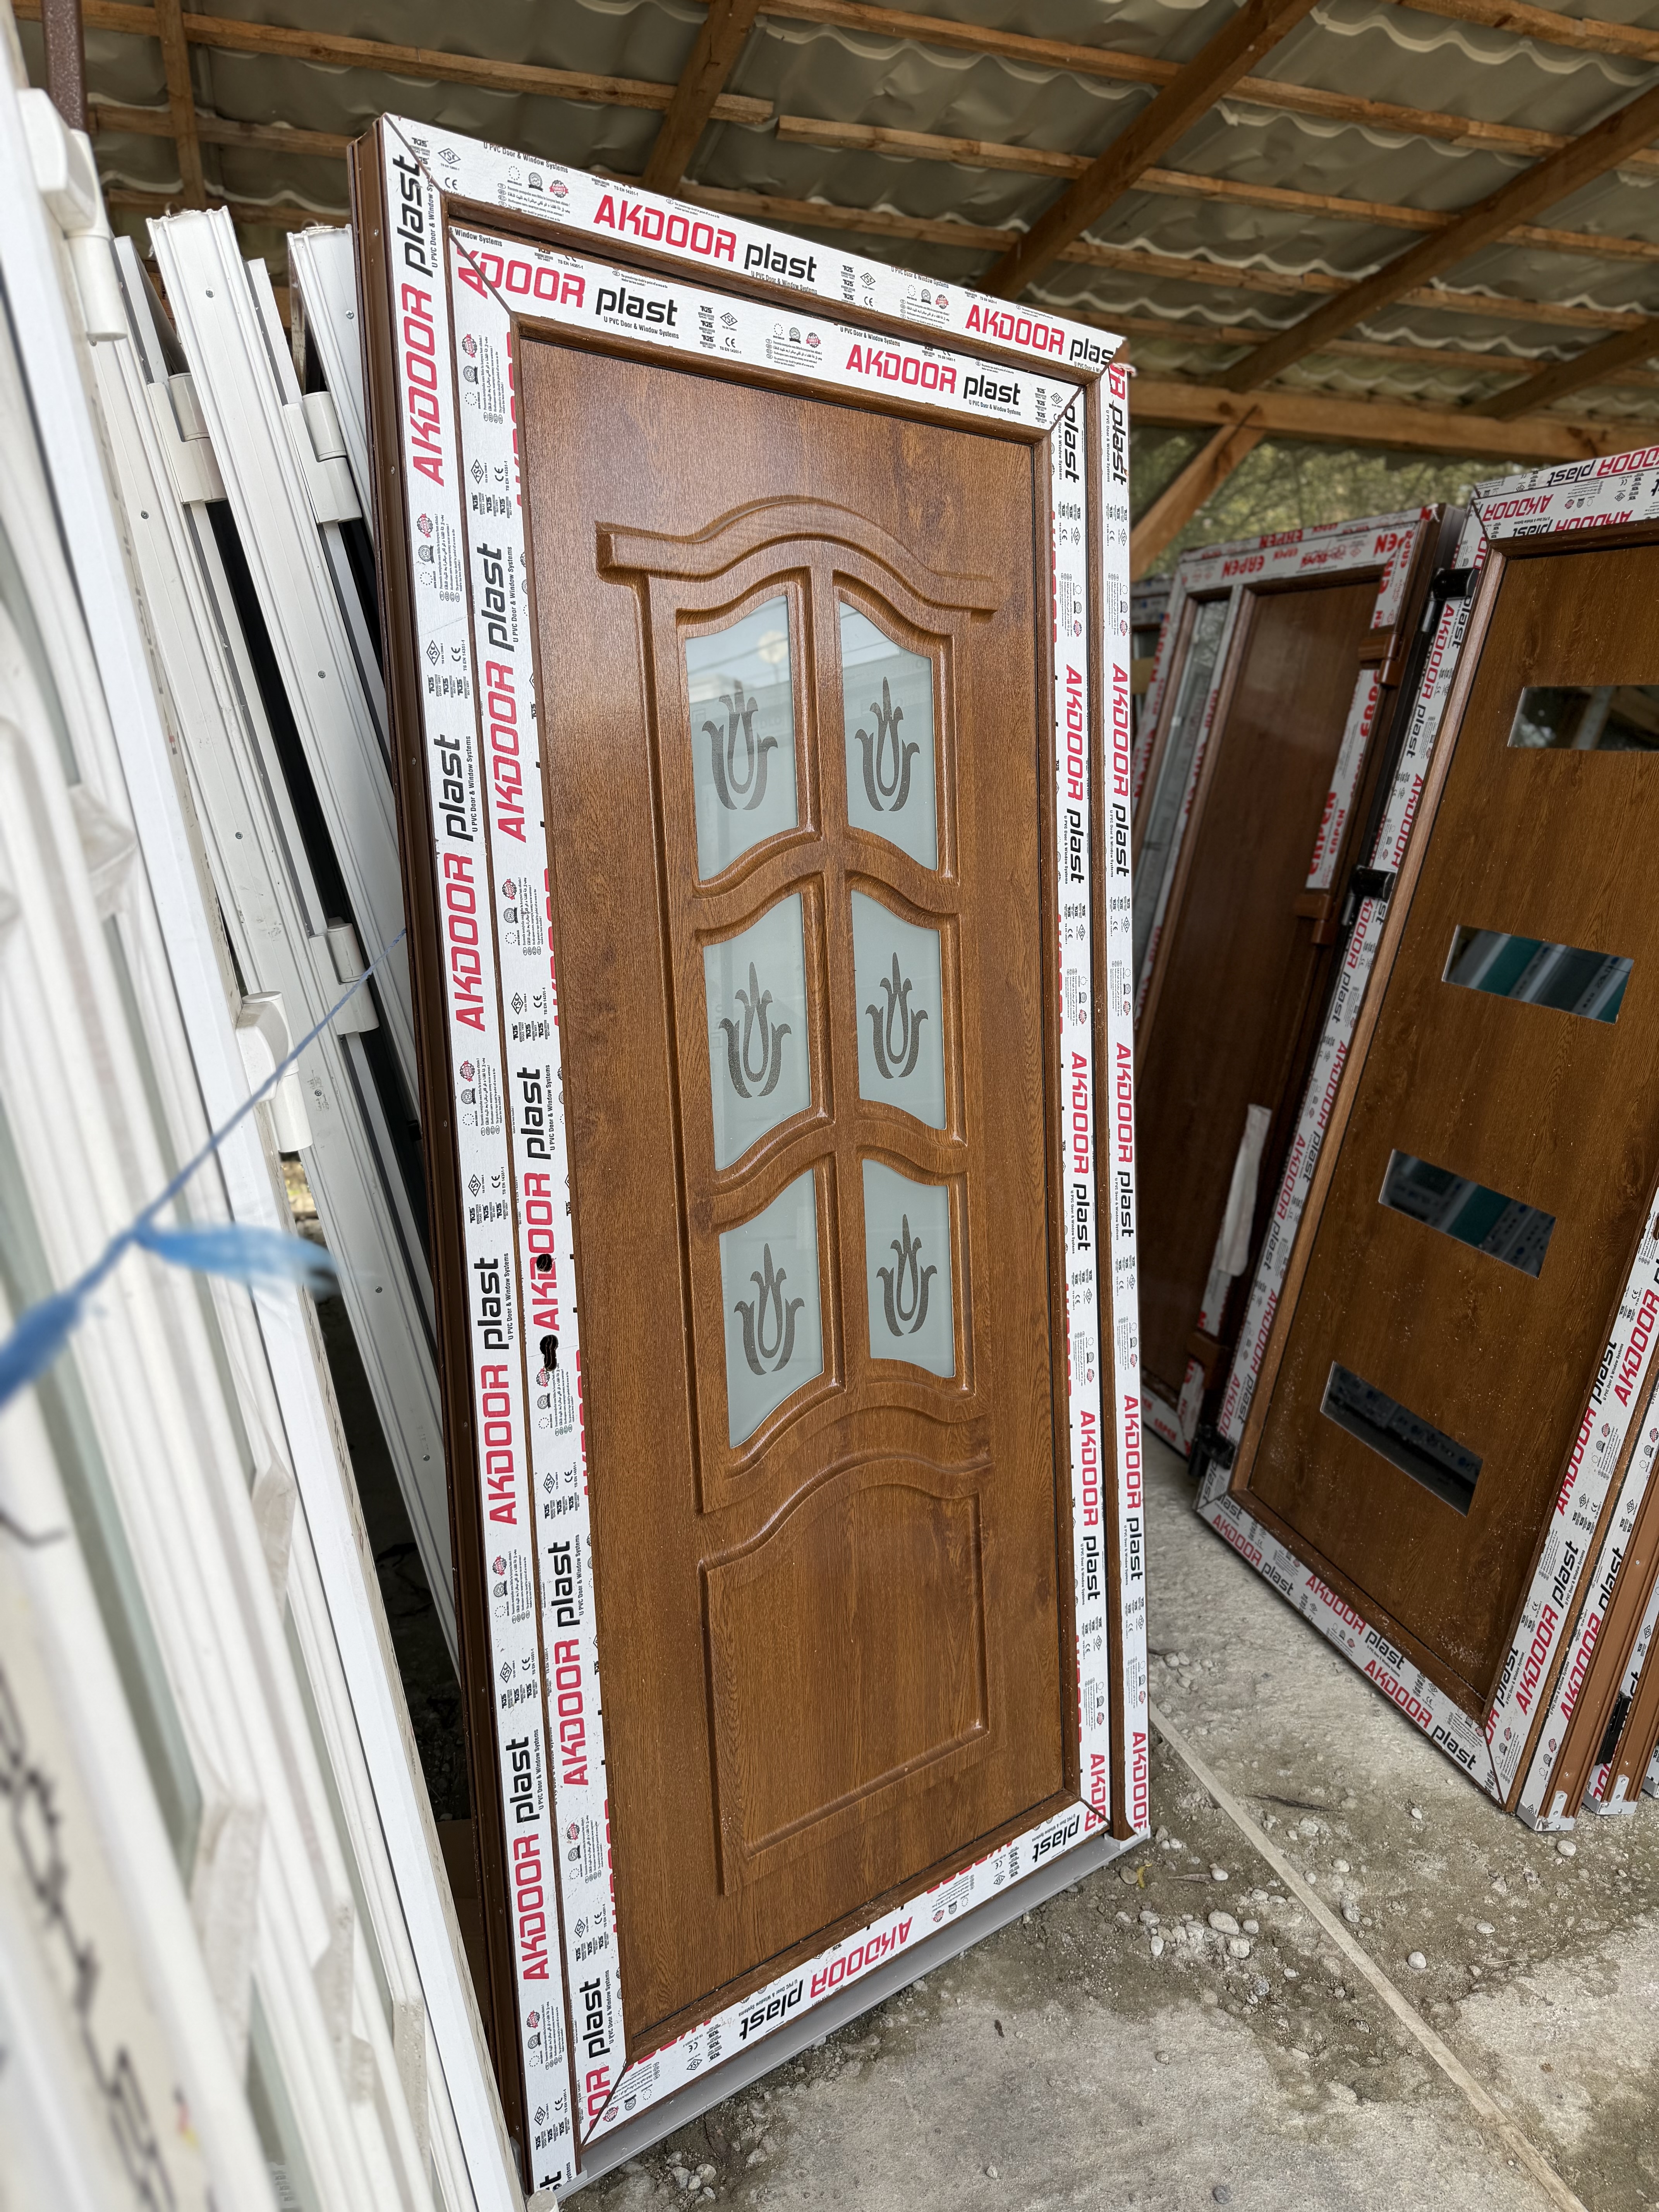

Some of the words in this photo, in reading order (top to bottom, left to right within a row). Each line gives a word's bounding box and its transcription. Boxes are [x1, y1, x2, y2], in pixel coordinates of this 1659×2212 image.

[392, 153, 433, 278] plast
[594, 195, 736, 262] AKDOOR
[744, 243, 817, 282] plast
[595, 287, 678, 326] plast
[609, 317, 619, 325] PVC
[620, 320, 632, 328] Door
[639, 324, 658, 334] Window
[659, 329, 679, 339] Systems
[965, 305, 1065, 355] AKDOOR
[1069, 338, 1118, 373] plas
[401, 283, 443, 486] AKDOOR
[846, 345, 957, 393] AKDOOR
[963, 374, 1021, 405] plast
[1109, 400, 1127, 486] plast
[1545, 460, 1597, 488] plast
[1596, 447, 1659, 477] DOOR
[1482, 495, 1553, 522] AKDOOR
[1512, 519, 1554, 538] plast
[1554, 511, 1632, 532] AKDOOR
[476, 543, 515, 653] plast
[451, 647, 461, 662] CE
[1422, 605, 1454, 699] AKDOOR
[486, 661, 526, 842] AKDOOR
[1066, 665, 1083, 801] AKDOOR
[1113, 664, 1128, 796] AKDOOR
[1406, 703, 1426, 758] plast
[433, 734, 474, 842] plast
[1392, 774, 1424, 868] AKDOOR
[1066, 808, 1084, 884] plast
[1112, 803, 1129, 877] plast
[1329, 808, 1346, 855] ERPEN
[443, 853, 485, 1031] AKDOOR
[1346, 900, 1373, 969] KDOOR
[1332, 971, 1351, 1023] plast
[517, 1067, 551, 1160] plast
[1072, 1052, 1089, 1174] AKDOOR
[1116, 1043, 1132, 1163] AKDOOR
[1317, 1041, 1347, 1130] AKDOOR
[1276, 1135, 1306, 1220] AKDOOR
[1303, 1129, 1325, 1184] plast
[1072, 1183, 1091, 1251] plast
[1117, 1171, 1134, 1237] plast
[1258, 1219, 1281, 1273] plast
[474, 1257, 509, 1350] plast
[1614, 1290, 1659, 1407] AKDOOR
[1218, 1375, 1240, 1437] AKDO
[1238, 1372, 1258, 1426] plast
[481, 1365, 517, 1525] AKDOOR
[1080, 1411, 1098, 1526] AKDOOR
[1124, 1396, 1141, 1509] AKDOOR
[548, 1541, 580, 1627] plast
[1082, 1536, 1101, 1602] plast
[1126, 1517, 1143, 1581] plast
[1212, 1515, 1262, 1567] AKDOOR
[1255, 1562, 1293, 1600] plast
[1305, 1575, 1367, 1635] AKDOOR
[1365, 1626, 1408, 1670] plast
[1516, 1604, 1558, 1714] AKDOOR
[1552, 1540, 1579, 1609] plast
[1560, 1613, 1602, 1720] AKDOOR
[1598, 1547, 1626, 1612] plast
[554, 1639, 588, 1785] AKDOOR
[1364, 1660, 1432, 1729] AKDOOR
[1429, 1724, 1476, 1781] plast
[505, 1736, 540, 1824] plast
[1032, 1815, 1080, 1863] plast
[513, 1834, 549, 1980] AKDOOR
[810, 1918, 912, 1998] AKDOOR
[579, 1977, 610, 2059] plast
[739, 1979, 804, 2040] plast
